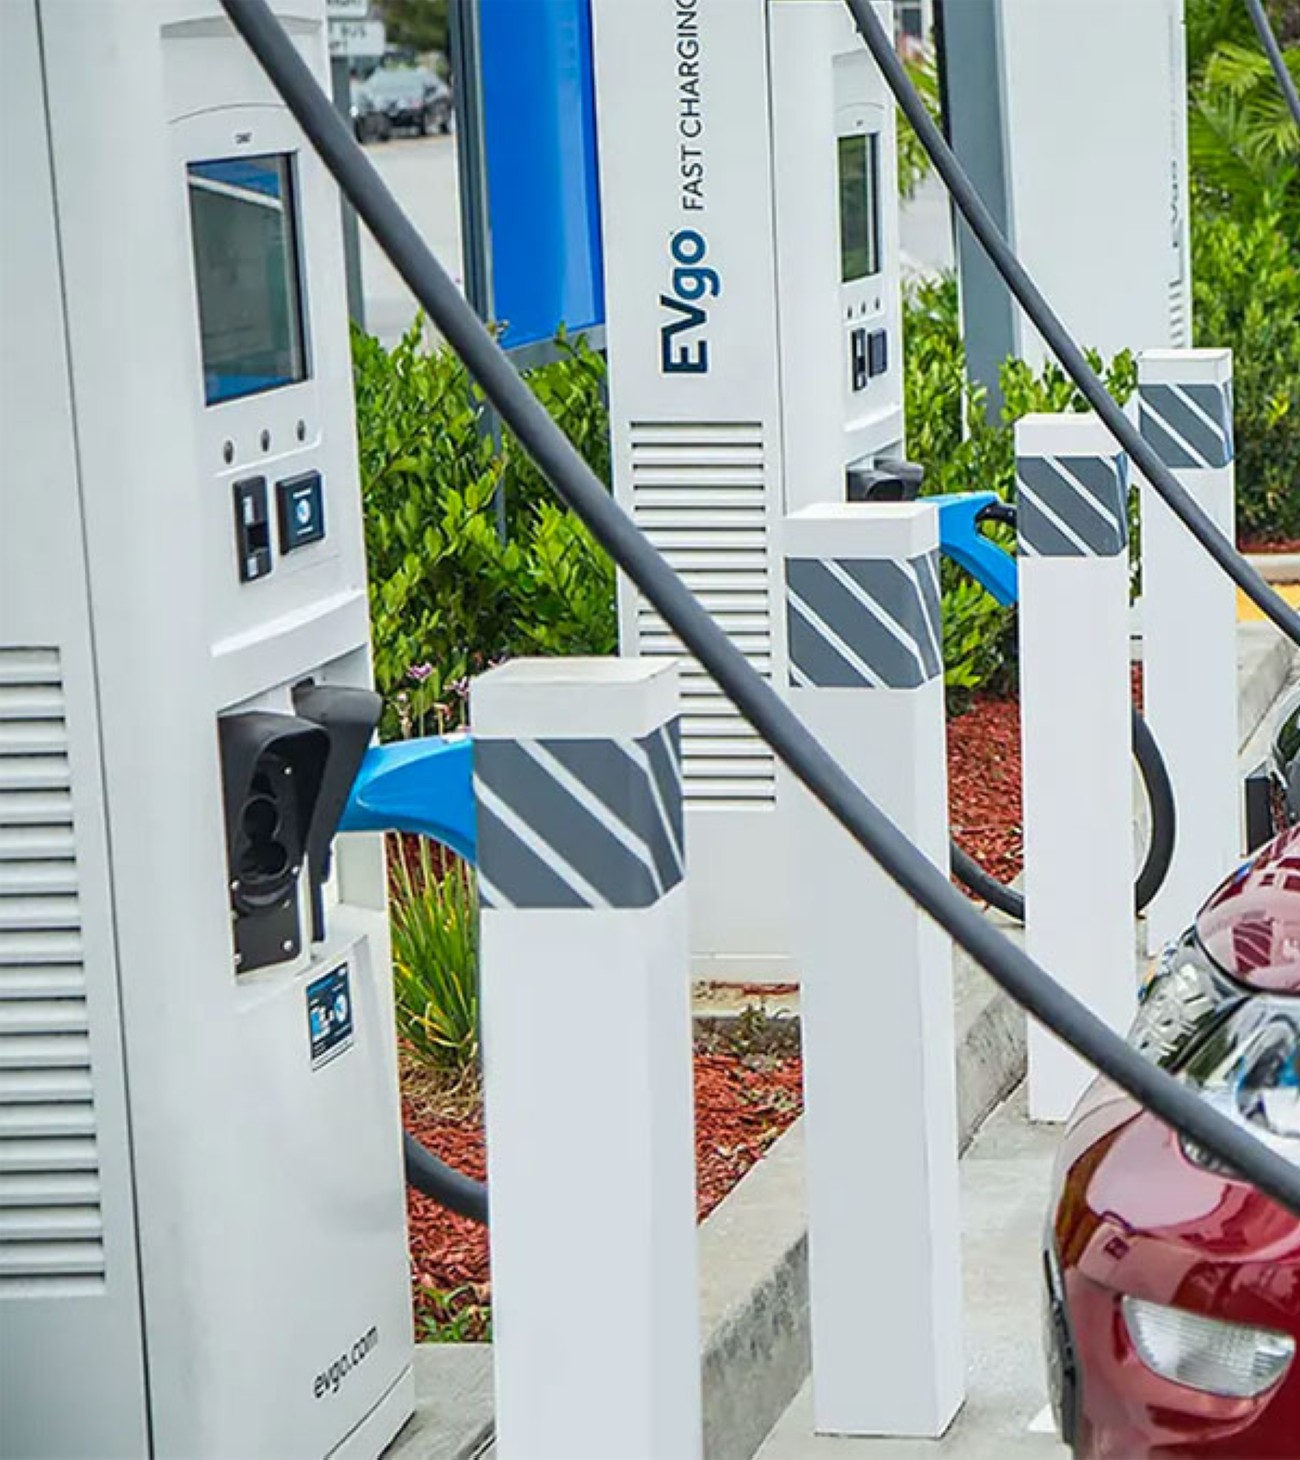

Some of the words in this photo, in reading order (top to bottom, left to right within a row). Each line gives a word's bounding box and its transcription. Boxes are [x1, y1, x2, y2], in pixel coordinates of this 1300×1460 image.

[681, 144, 704, 211] FAST
[660, 229, 721, 374] EVgo
[314, 1326, 378, 1398] evgo.com
